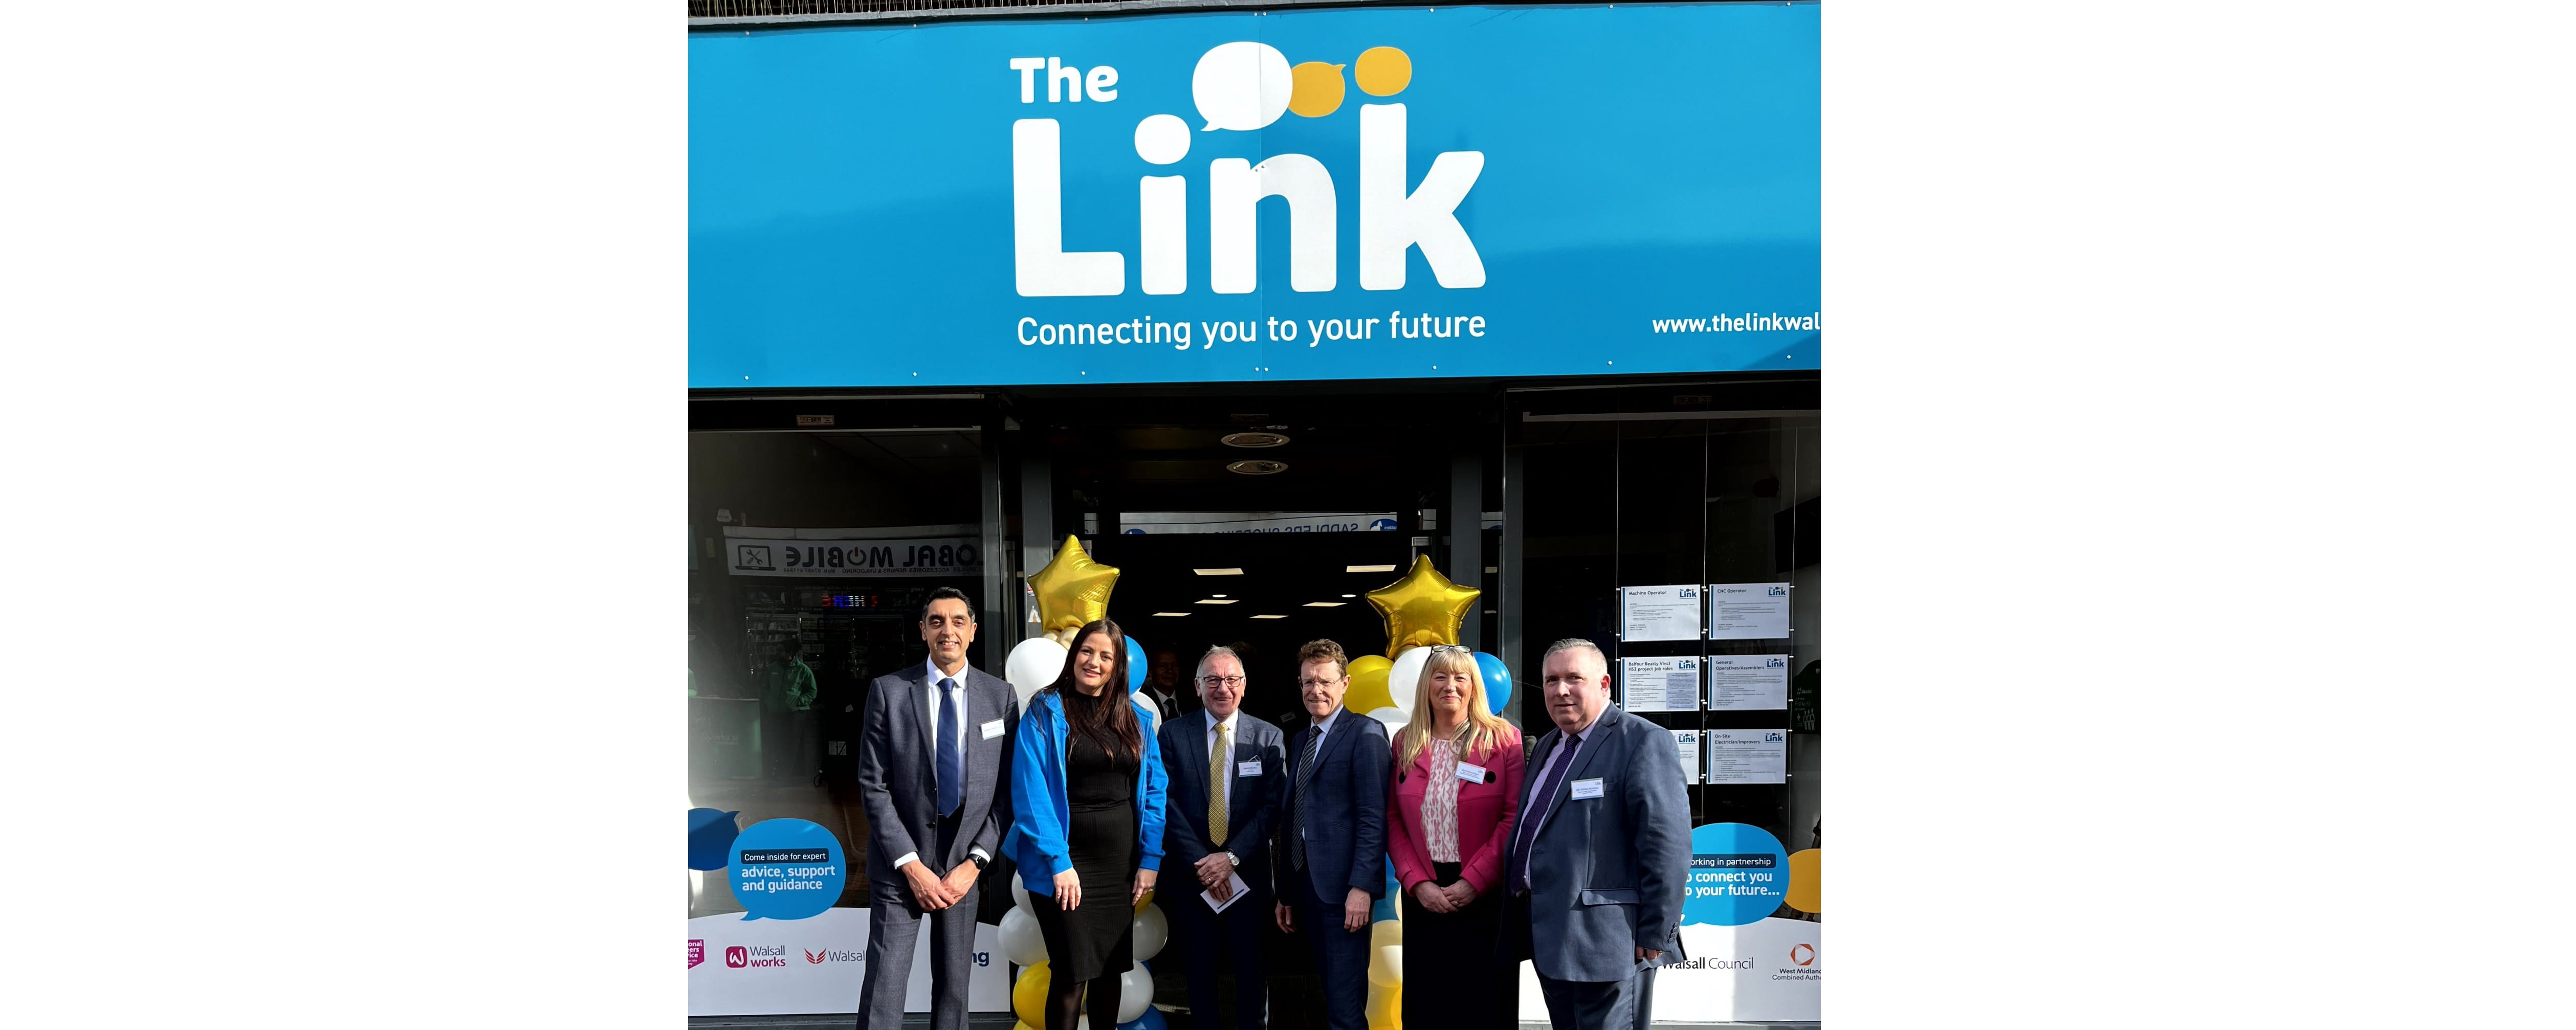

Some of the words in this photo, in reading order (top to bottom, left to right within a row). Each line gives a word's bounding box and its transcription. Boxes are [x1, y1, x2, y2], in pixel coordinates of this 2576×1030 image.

[1010, 57, 1119, 103] The
[1012, 102, 1486, 297] Link
[1652, 312, 1820, 333] www.thelinkwal
[1017, 316, 1191, 350] Connecting
[1201, 319, 1257, 349] you
[1267, 315, 1297, 342] to
[1310, 314, 1380, 347] your
[1389, 310, 1486, 340] future
[803, 853, 826, 861] expert
[1691, 858, 1715, 867] orking
[1726, 858, 1771, 867] partnership
[741, 866, 784, 879] advice,
[788, 865, 835, 879] support
[1686, 873, 1692, 882] o
[1696, 871, 1746, 882] connect
[1749, 872, 1772, 885] you
[742, 879, 765, 891] and
[768, 878, 823, 893] guidance
[1685, 886, 1692, 896] o
[1695, 886, 1725, 899] your
[1728, 884, 1780, 896] future...
[749, 945, 785, 956] Walsall
[828, 950, 866, 962] Walsal
[750, 957, 786, 967] works
[1708, 957, 1754, 969] Council
